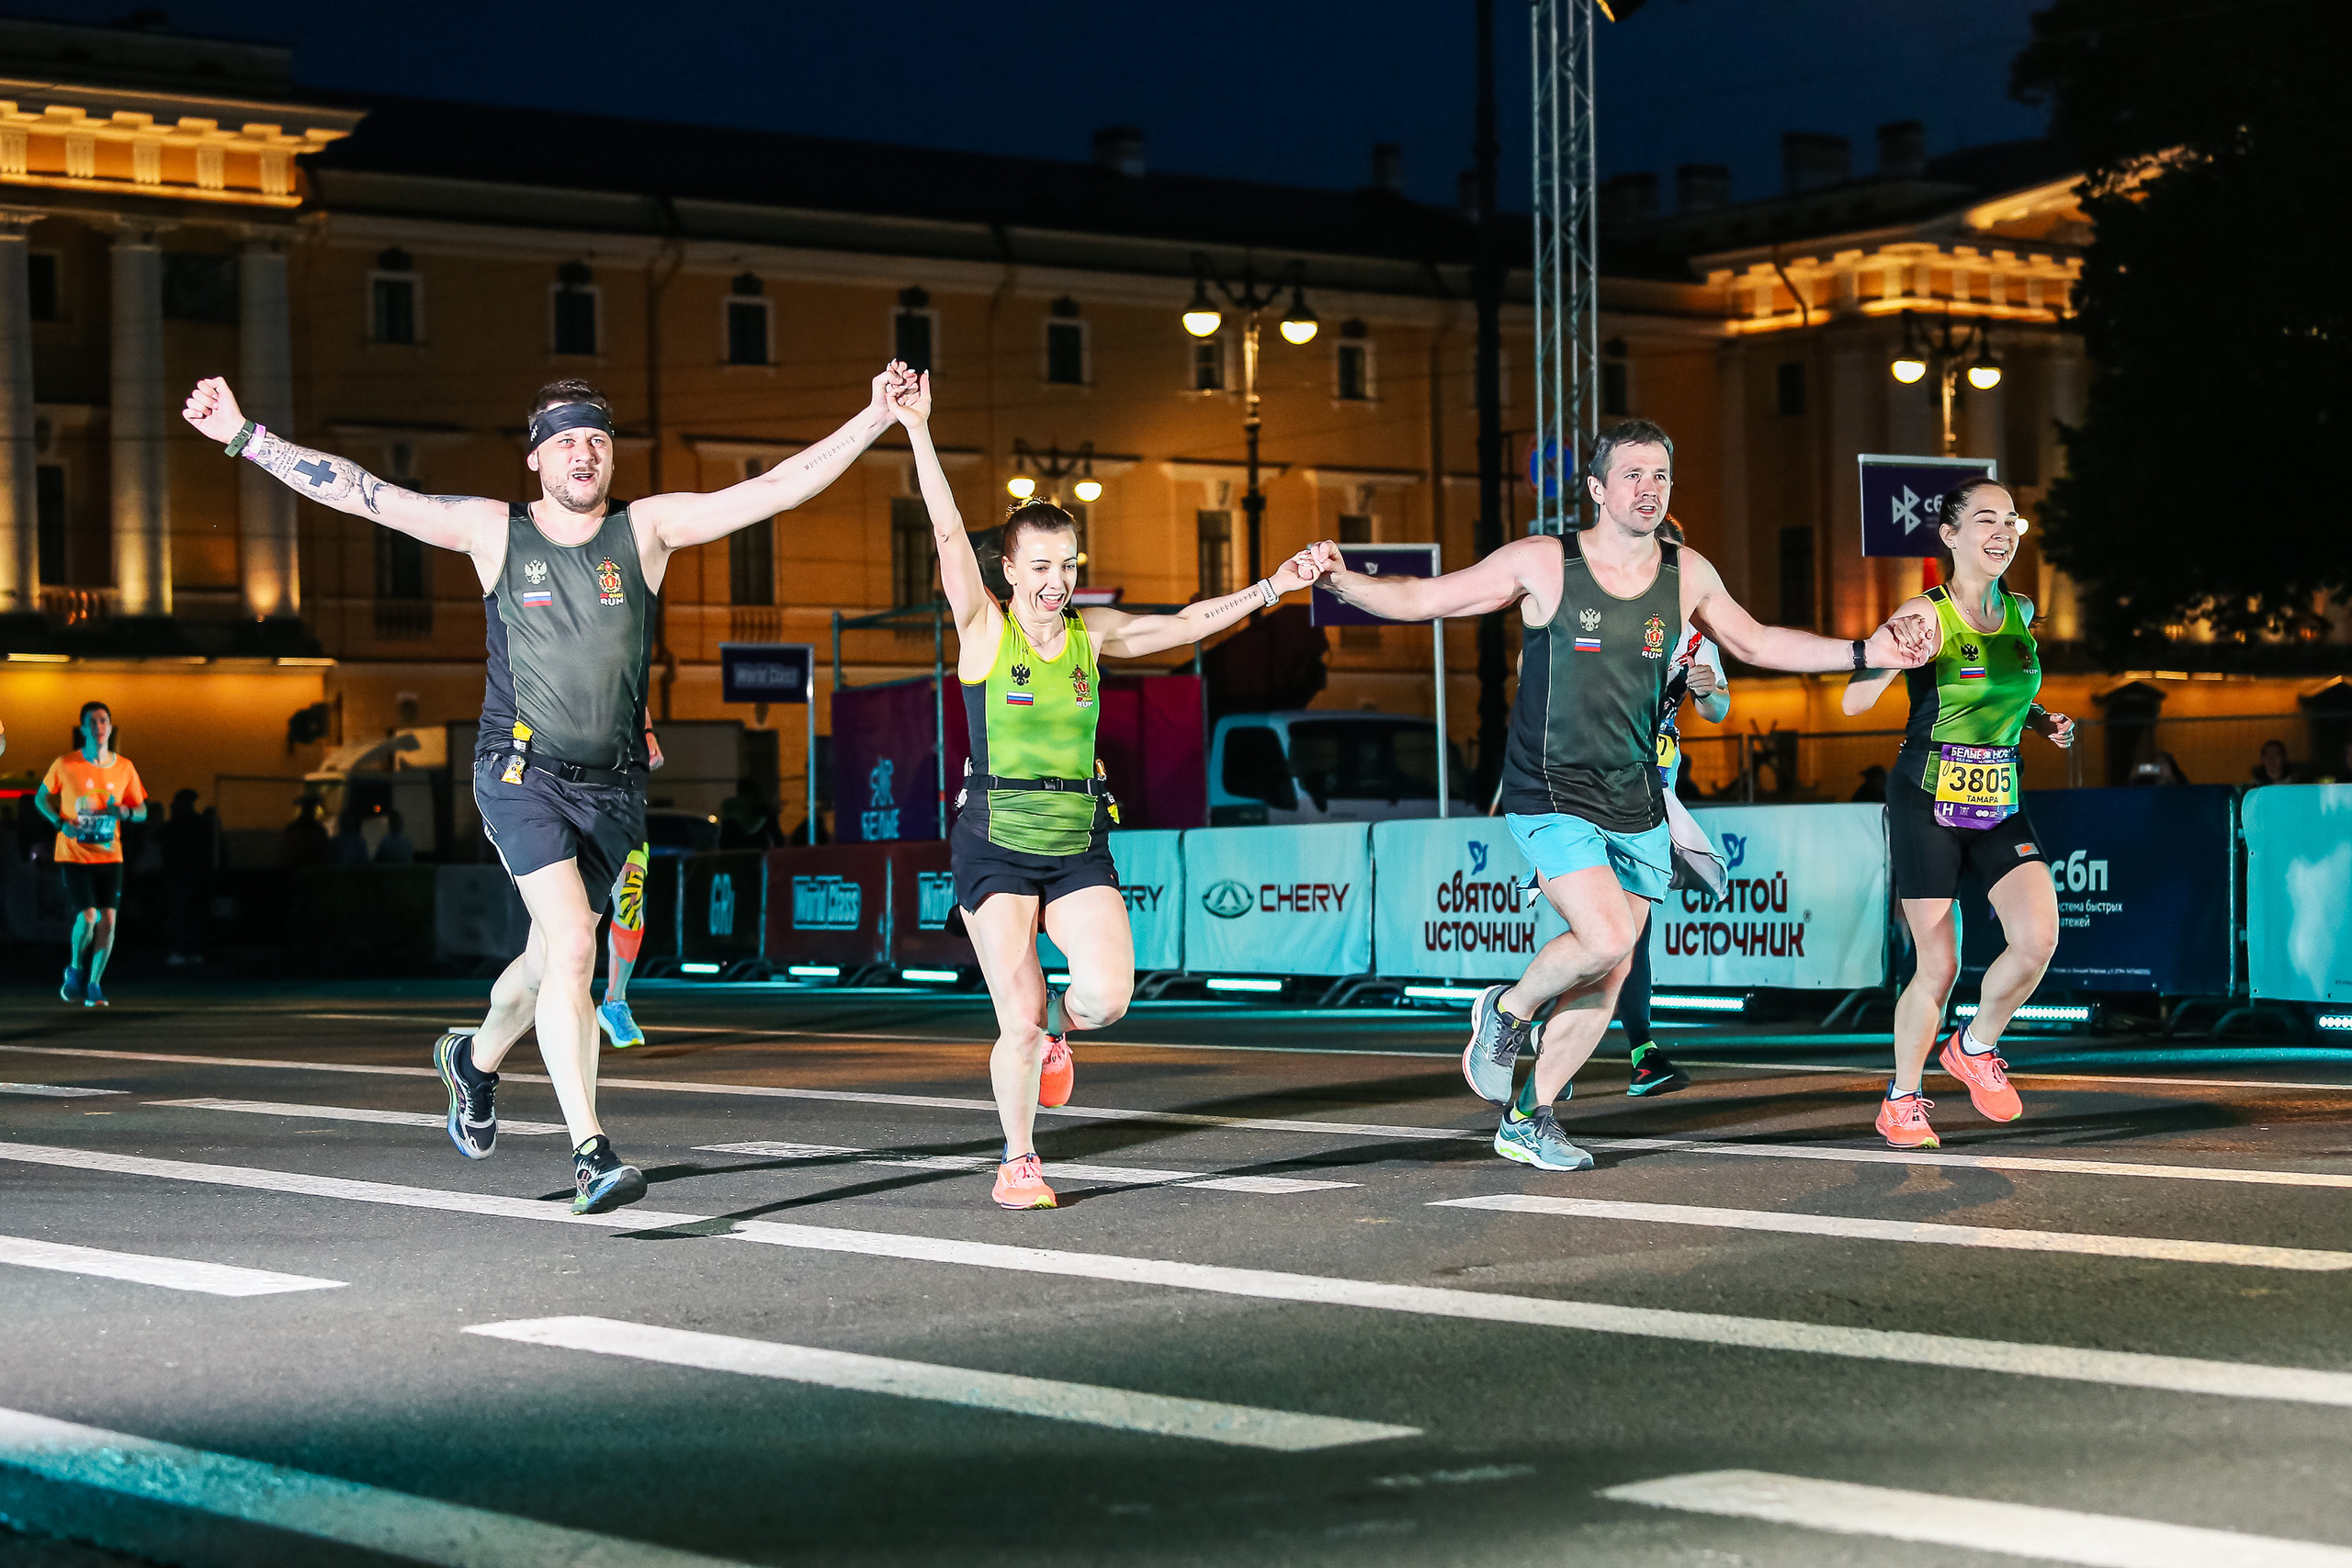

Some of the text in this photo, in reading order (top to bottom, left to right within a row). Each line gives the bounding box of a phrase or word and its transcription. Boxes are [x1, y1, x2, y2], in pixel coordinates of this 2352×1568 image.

[600, 597, 624, 606] RUN
[1641, 650, 1663, 659] RUN
[1951, 746, 1982, 760] БЕЛЫЕ
[1949, 766, 2012, 794] 3805
[1966, 795, 1999, 804] ТАМАРА
[2051, 849, 2109, 893] сбп
[1260, 883, 1351, 912] CHERY
[2086, 898, 2123, 915] быстрых
